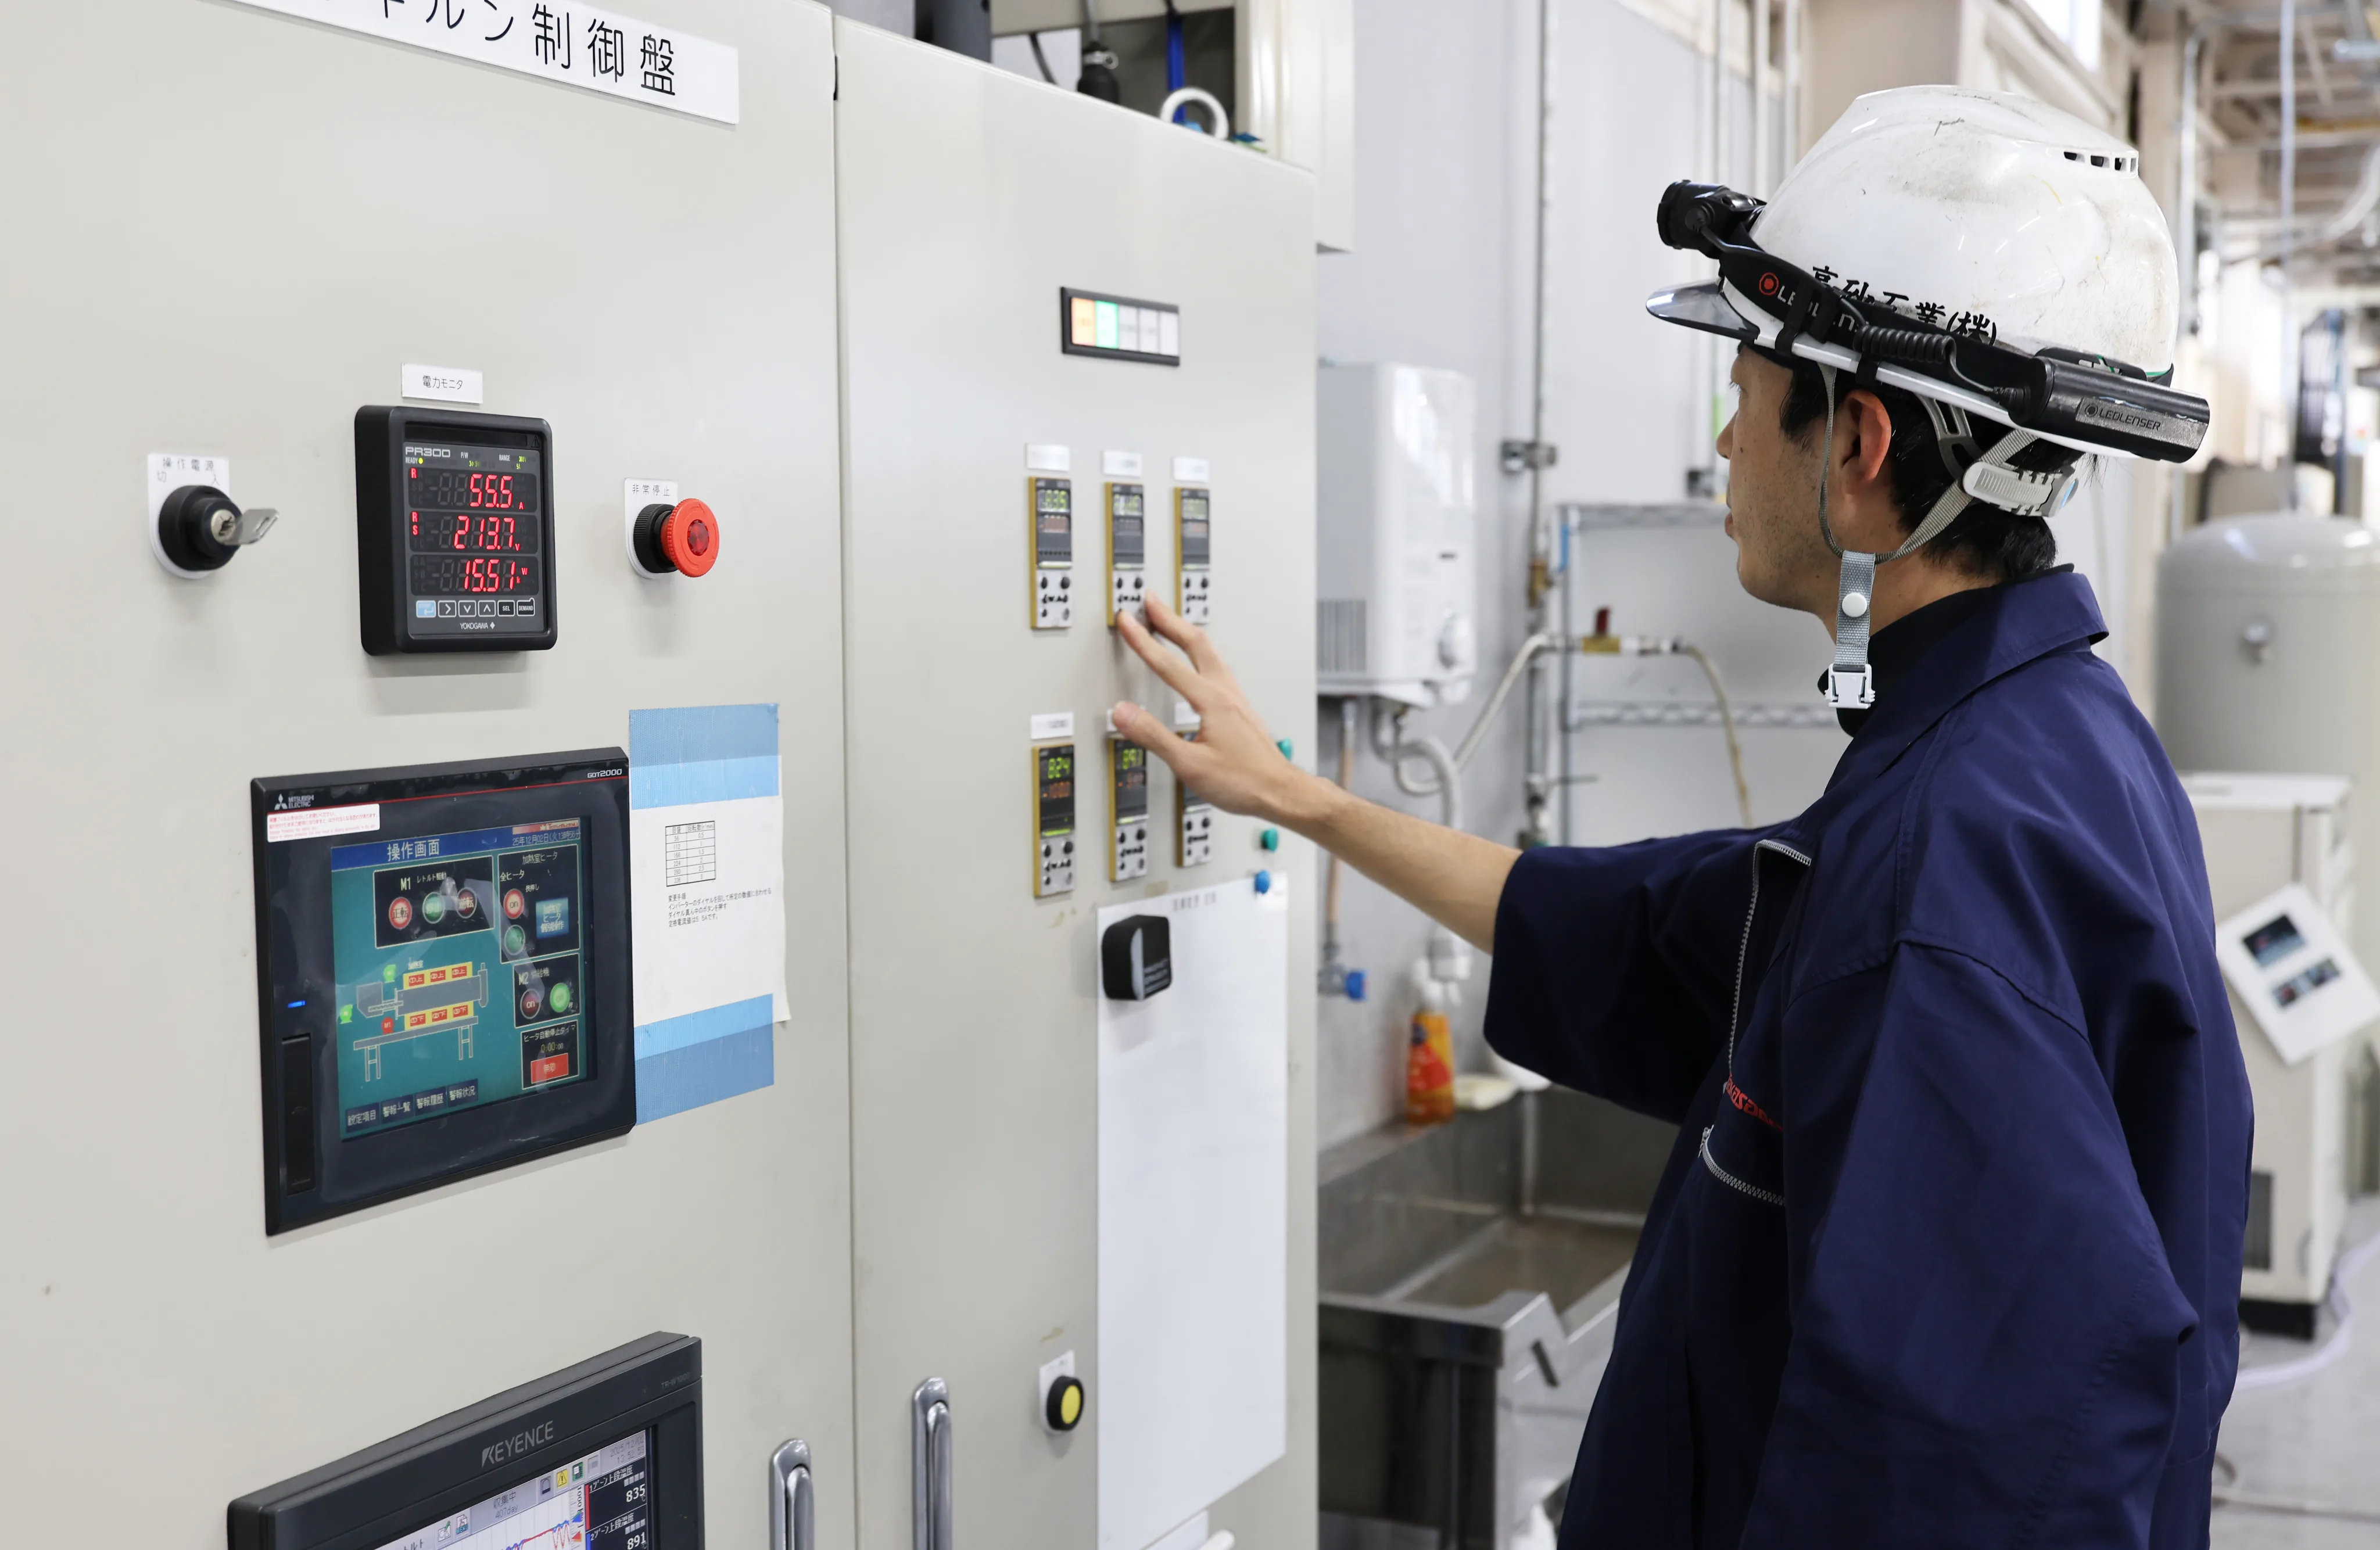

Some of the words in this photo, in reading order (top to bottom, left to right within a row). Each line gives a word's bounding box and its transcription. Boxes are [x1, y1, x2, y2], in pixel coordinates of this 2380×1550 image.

[422, 375, 463, 390] 電力モニタ
[2099, 409, 2162, 431] LEDLENSER
[405, 446, 451, 458] PR300
[162, 457, 214, 472] 操作電源
[156, 471, 167, 483] 切
[210, 474, 220, 486] 入
[411, 467, 418, 479] R
[469, 473, 513, 508] 55.5
[632, 483, 671, 496] 非常停止
[518, 501, 524, 510] A
[411, 511, 419, 523] R
[412, 525, 419, 536] S
[453, 515, 515, 550] 213.7
[515, 543, 521, 551] V
[463, 558, 517, 592] 15.51
[587, 769, 622, 778] GOT2000
[387, 838, 440, 862] 操作画面
[500, 869, 525, 882] 全ヒータ
[400, 877, 411, 891] M1
[525, 883, 539, 893] 長押し
[510, 900, 518, 909] on
[543, 913, 561, 923] ヒータ
[518, 972, 529, 985] M2
[526, 1000, 535, 1009] on
[481, 1420, 554, 1468] KEYENCE
[626, 1483, 646, 1502] 835
[493, 1491, 517, 1509] 収集中
[494, 1504, 518, 1520] 407day
[627, 1532, 646, 1550] 891
